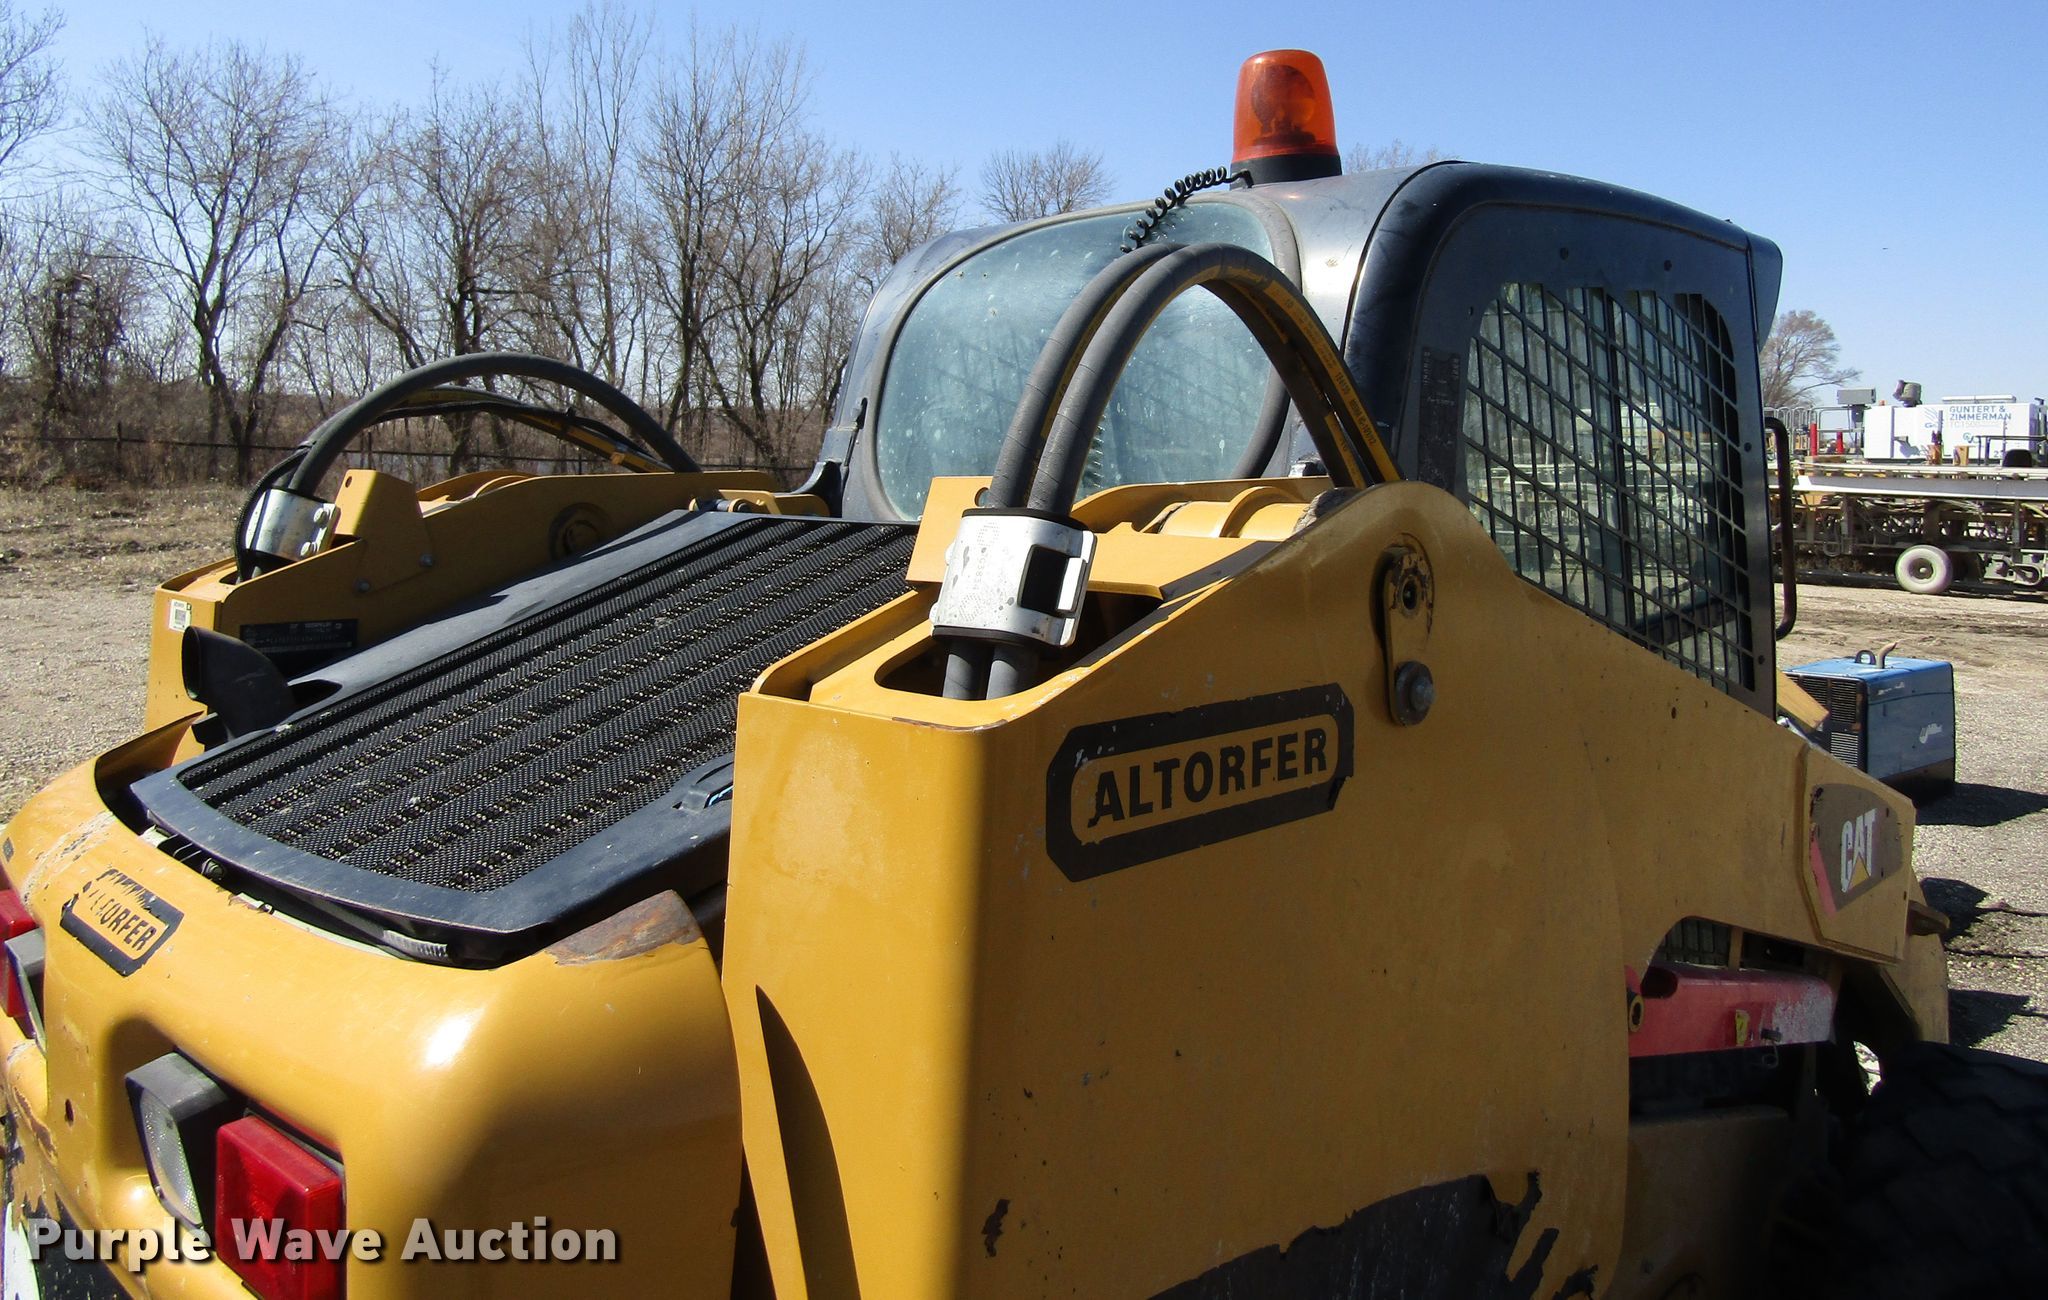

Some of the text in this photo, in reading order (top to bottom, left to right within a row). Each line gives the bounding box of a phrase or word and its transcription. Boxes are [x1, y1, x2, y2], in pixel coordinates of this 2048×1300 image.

[1949, 405, 2006, 413] GUNTERT &
[1949, 413, 2012, 421] ZIMMERMAN
[1087, 727, 1328, 829] ALTORFER
[1841, 808, 1877, 893] CAT
